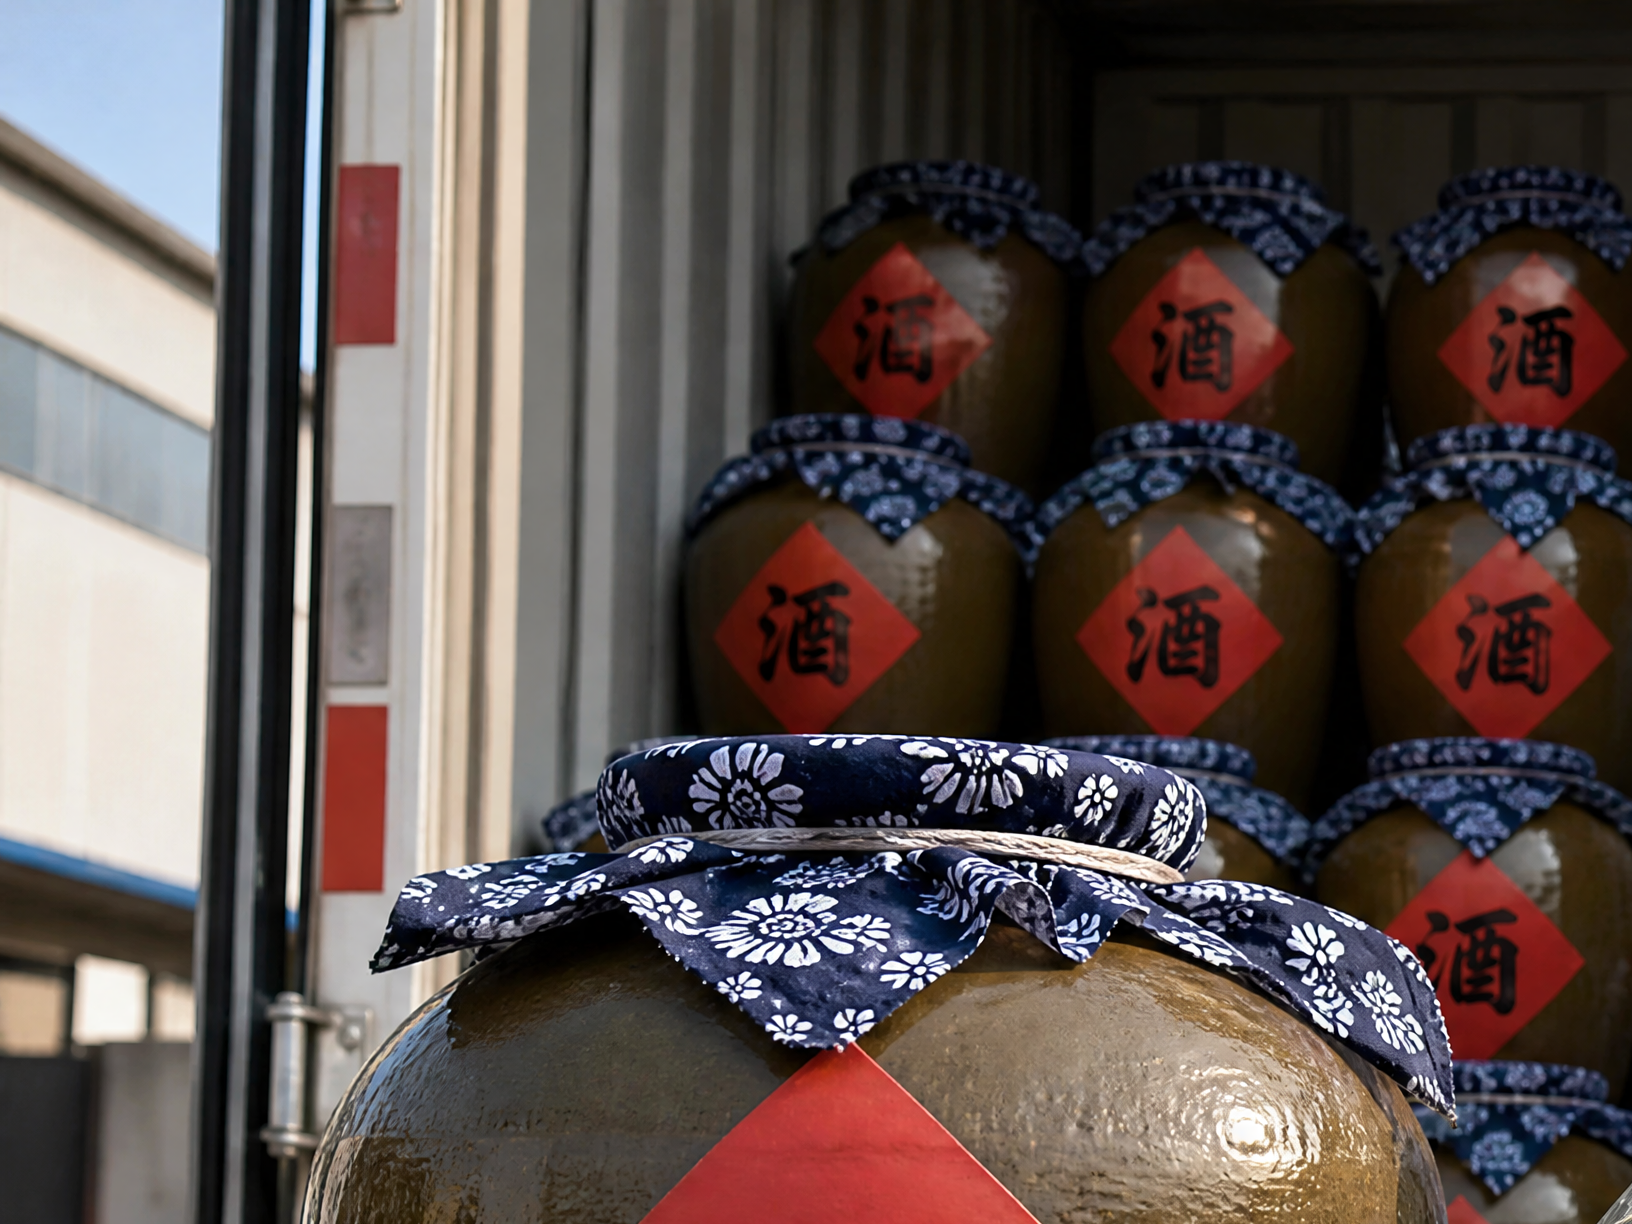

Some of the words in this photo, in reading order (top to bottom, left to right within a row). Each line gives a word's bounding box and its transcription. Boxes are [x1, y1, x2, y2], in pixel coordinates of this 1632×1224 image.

[853, 293, 934, 384] 酒
[1151, 302, 1233, 392] 酒
[1488, 306, 1574, 397] 酒
[757, 580, 853, 688] 酒
[1127, 586, 1220, 688] 酒
[1457, 594, 1551, 695] 酒
[1415, 909, 1519, 1016] 酒
